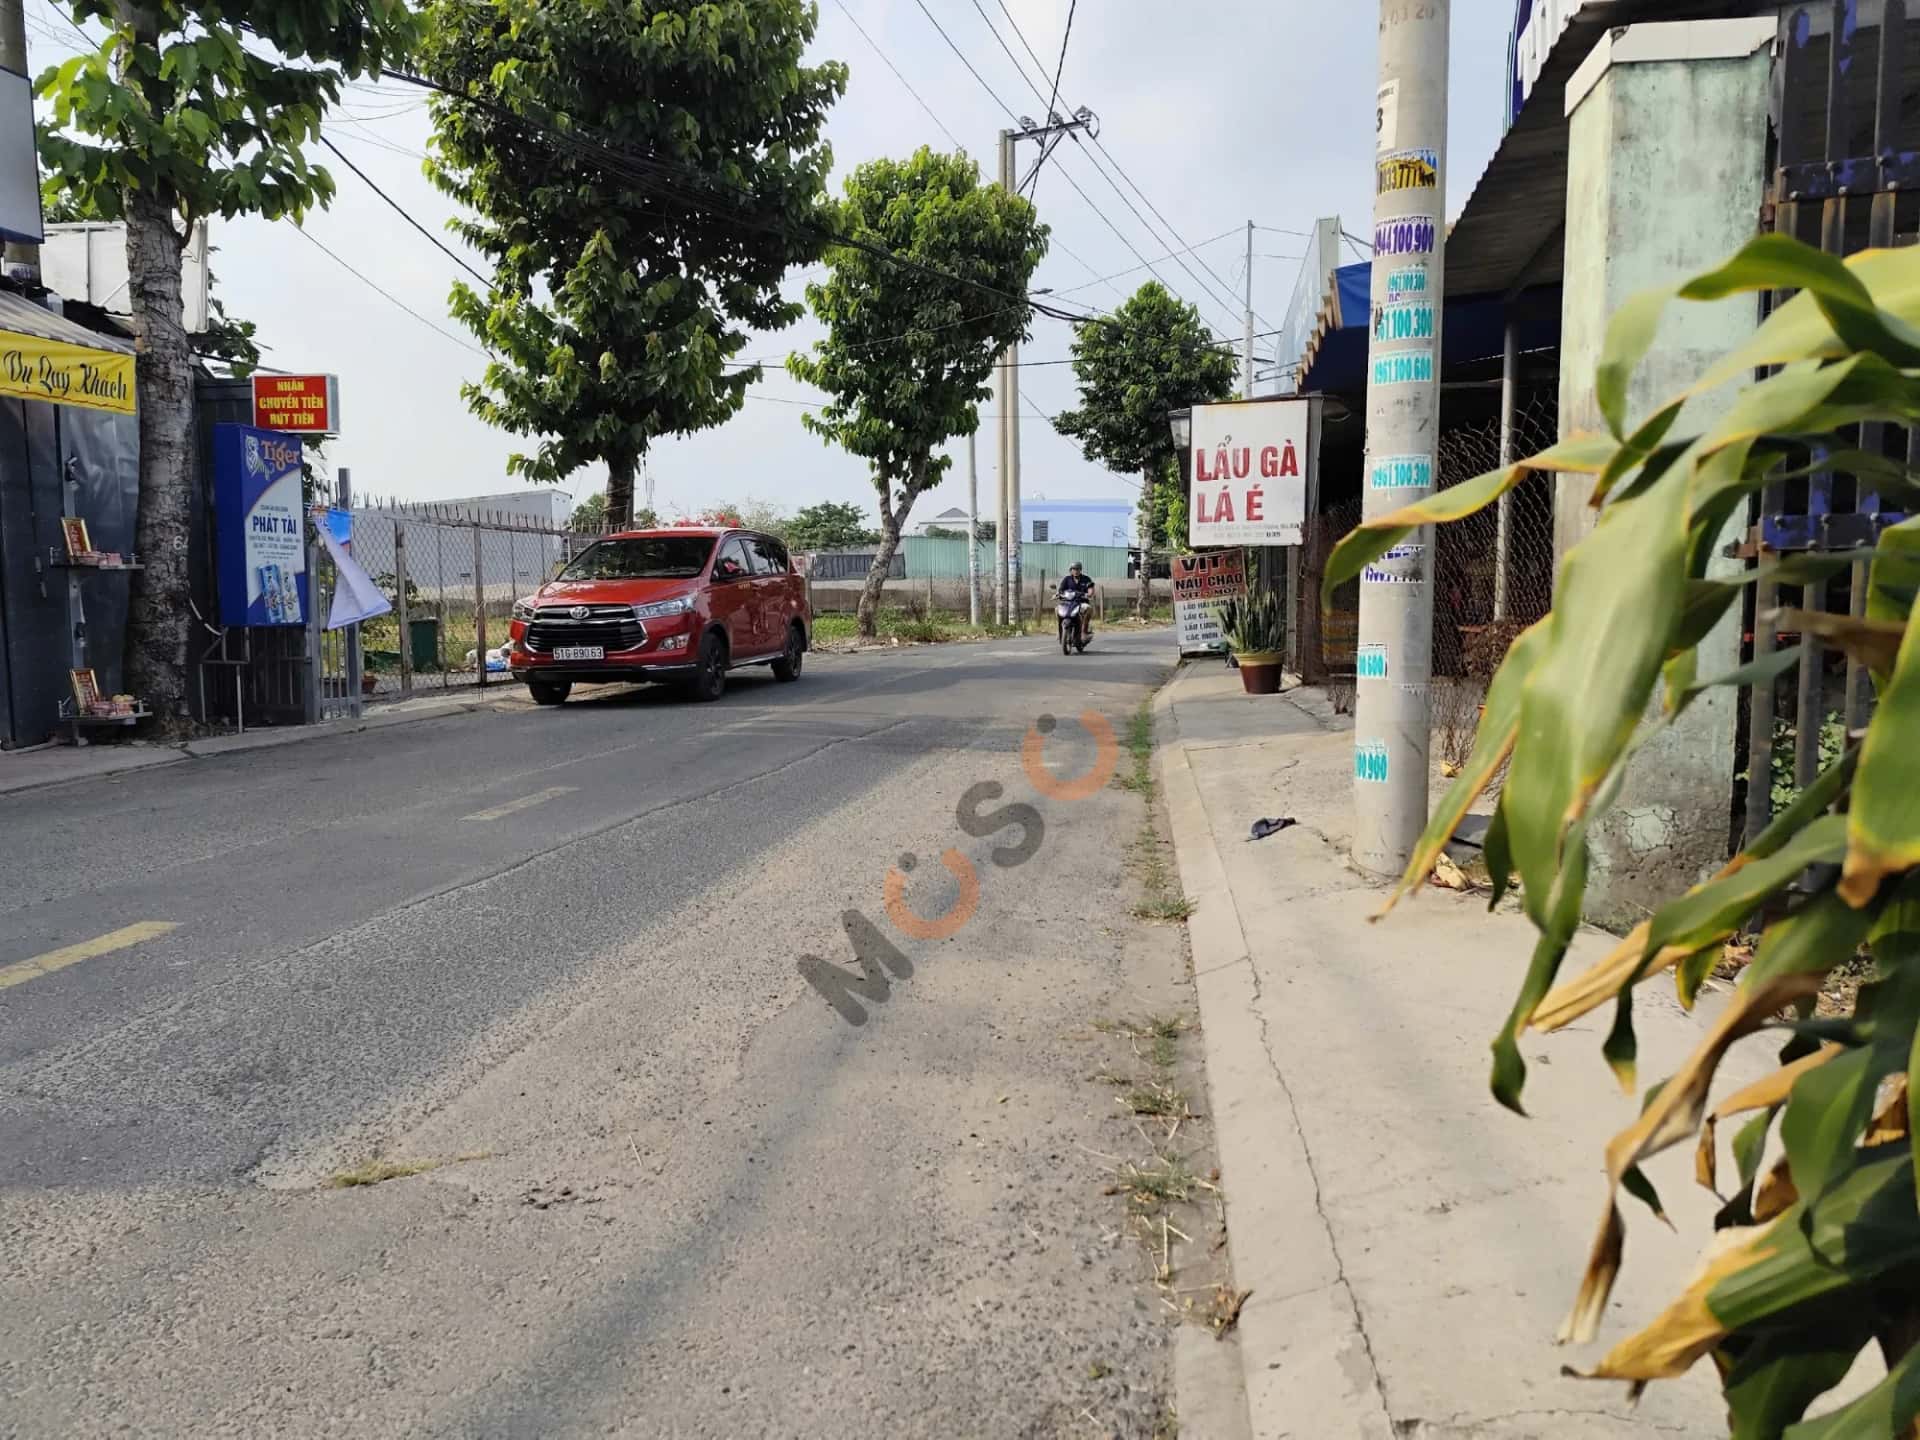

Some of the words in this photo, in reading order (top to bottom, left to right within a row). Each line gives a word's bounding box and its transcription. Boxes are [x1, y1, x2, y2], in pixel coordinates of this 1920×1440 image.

[260, 440, 300, 471] Tiger
[1196, 434, 1250, 482] LẨU
[1260, 439, 1299, 478] GÀ
[1197, 485, 1235, 523] LÁ
[1246, 484, 1264, 521] É
[252, 512, 279, 533] PHÁT
[281, 514, 297, 535] TÀI
